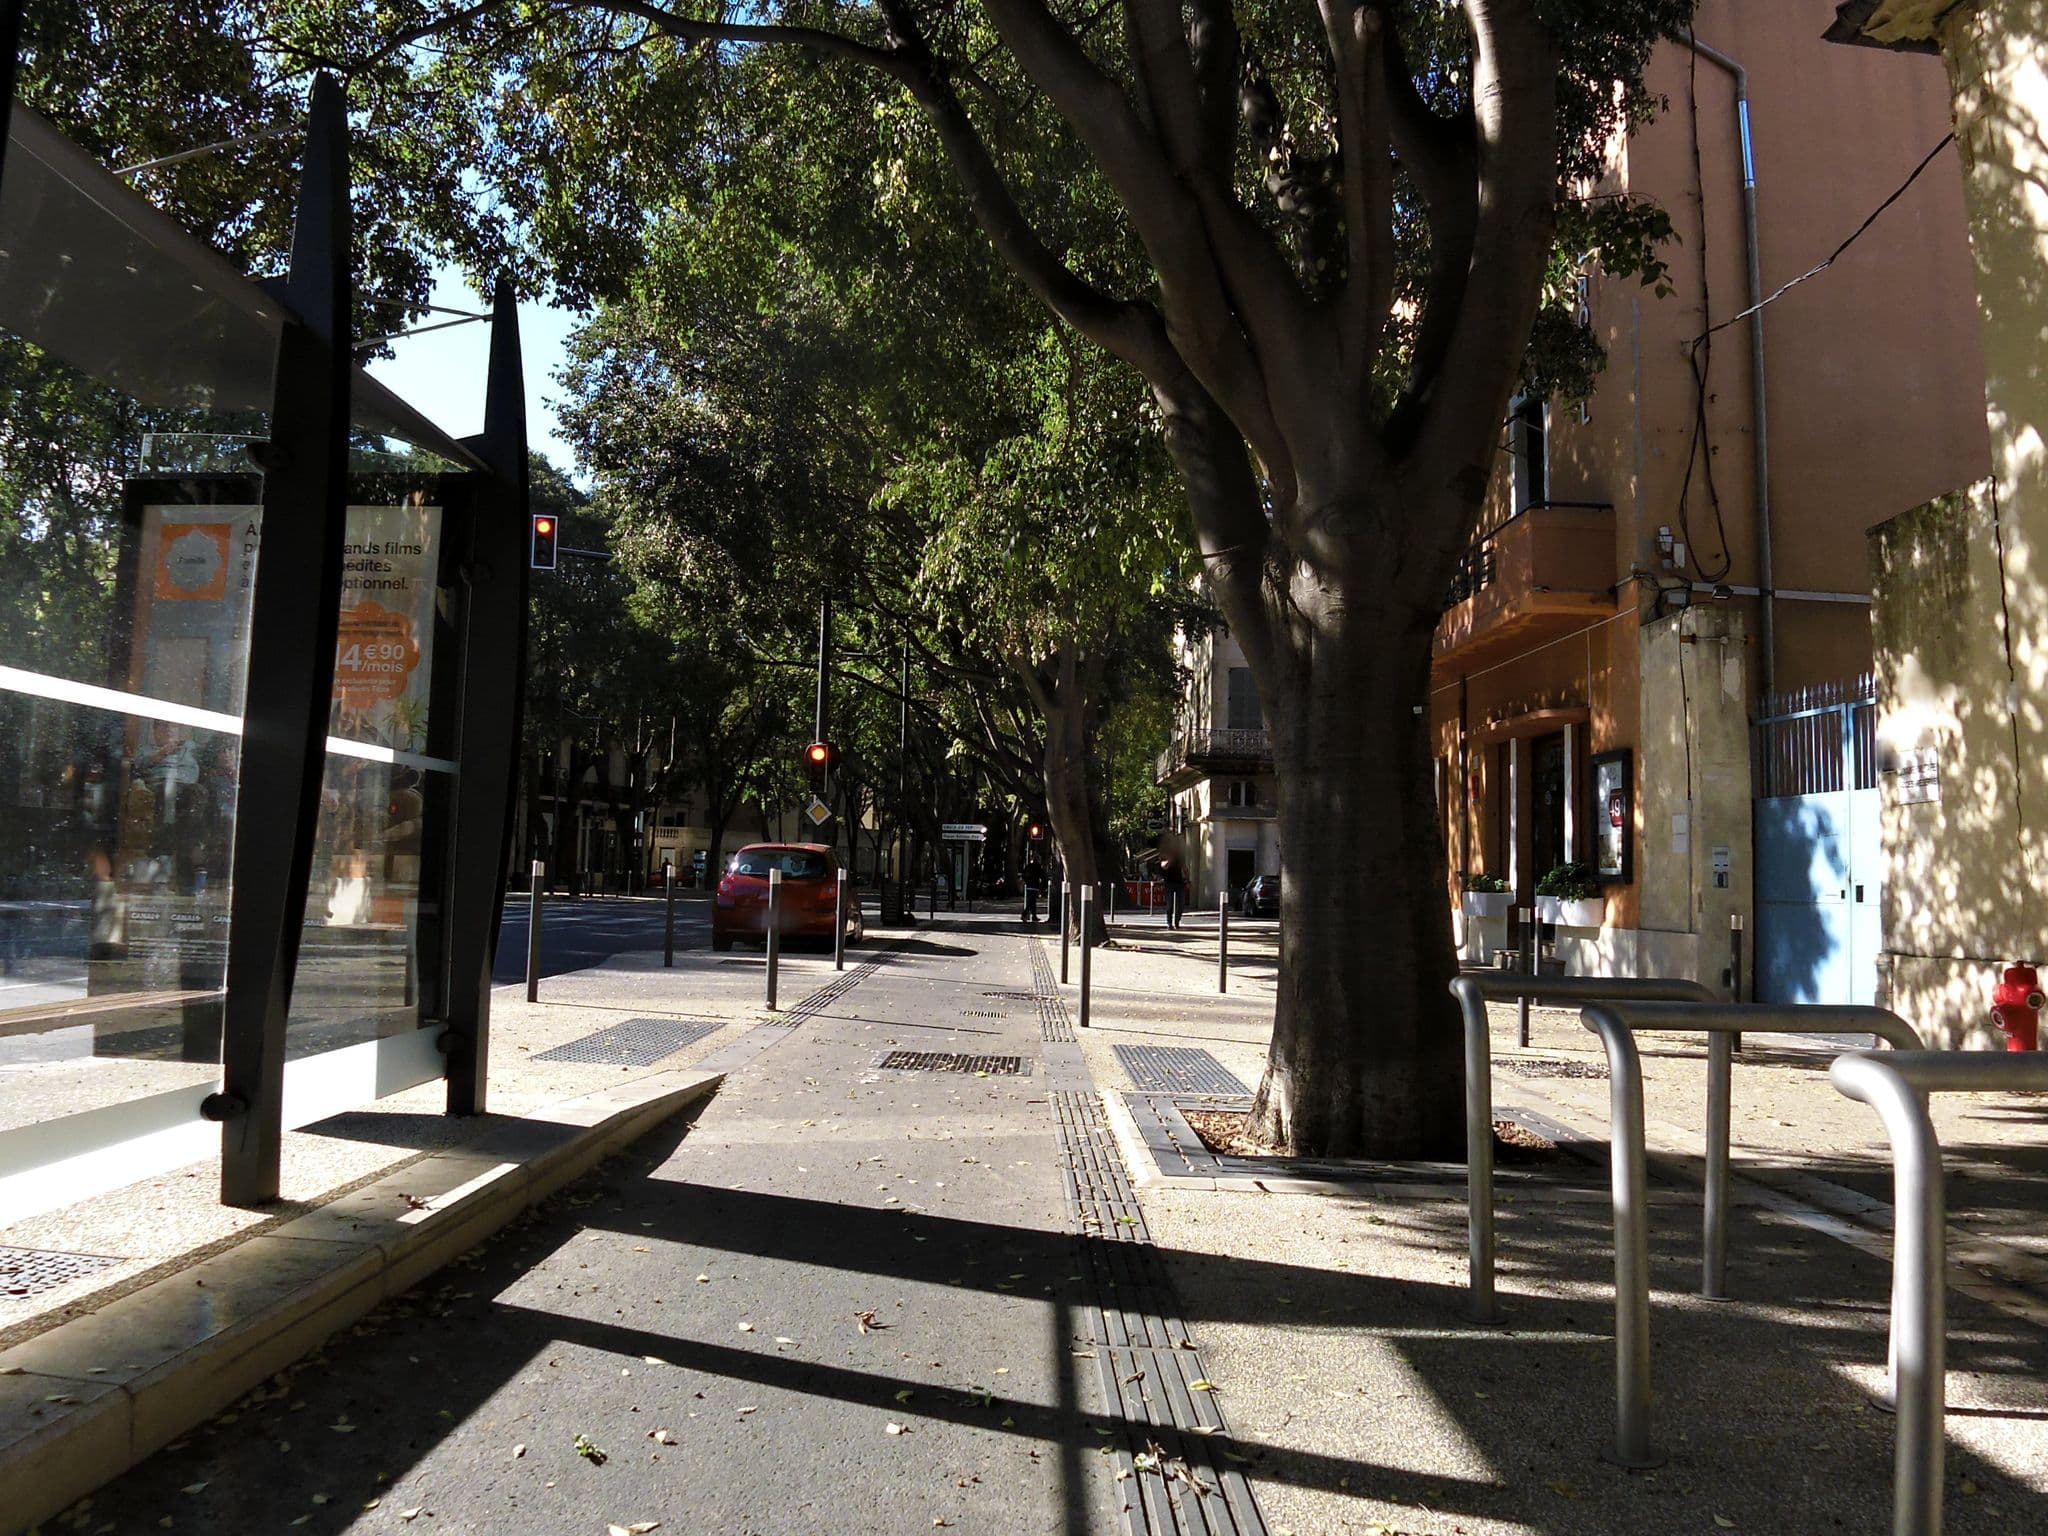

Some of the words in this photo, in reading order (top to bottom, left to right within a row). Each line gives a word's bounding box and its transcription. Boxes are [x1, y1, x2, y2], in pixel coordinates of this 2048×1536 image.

[343, 541, 380, 555] ands
[385, 541, 422, 555] films
[343, 576, 408, 592] ptionnel.
